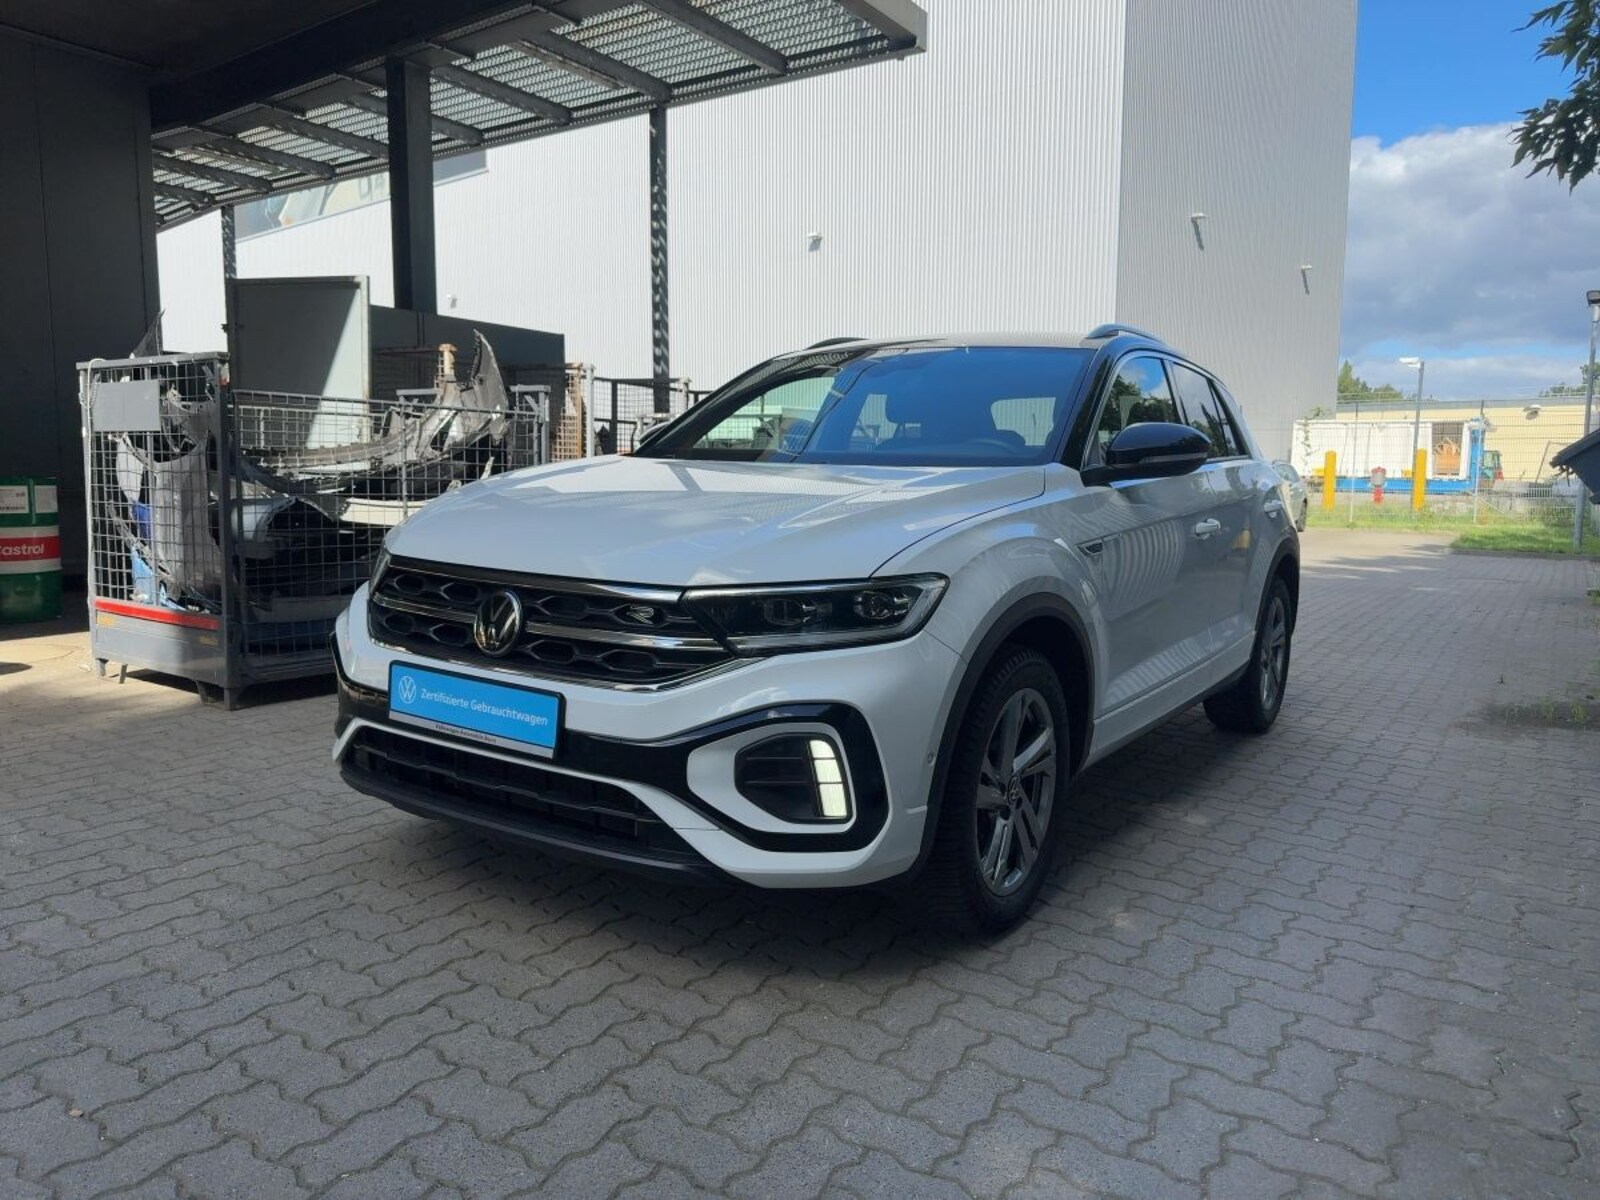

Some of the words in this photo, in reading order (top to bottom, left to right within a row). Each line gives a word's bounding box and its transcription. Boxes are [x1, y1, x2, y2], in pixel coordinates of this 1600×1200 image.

[0, 544, 45, 556] astrol
[421, 688, 469, 709] Zertifizierte
[470, 699, 548, 726] Gebrauchtwagen
